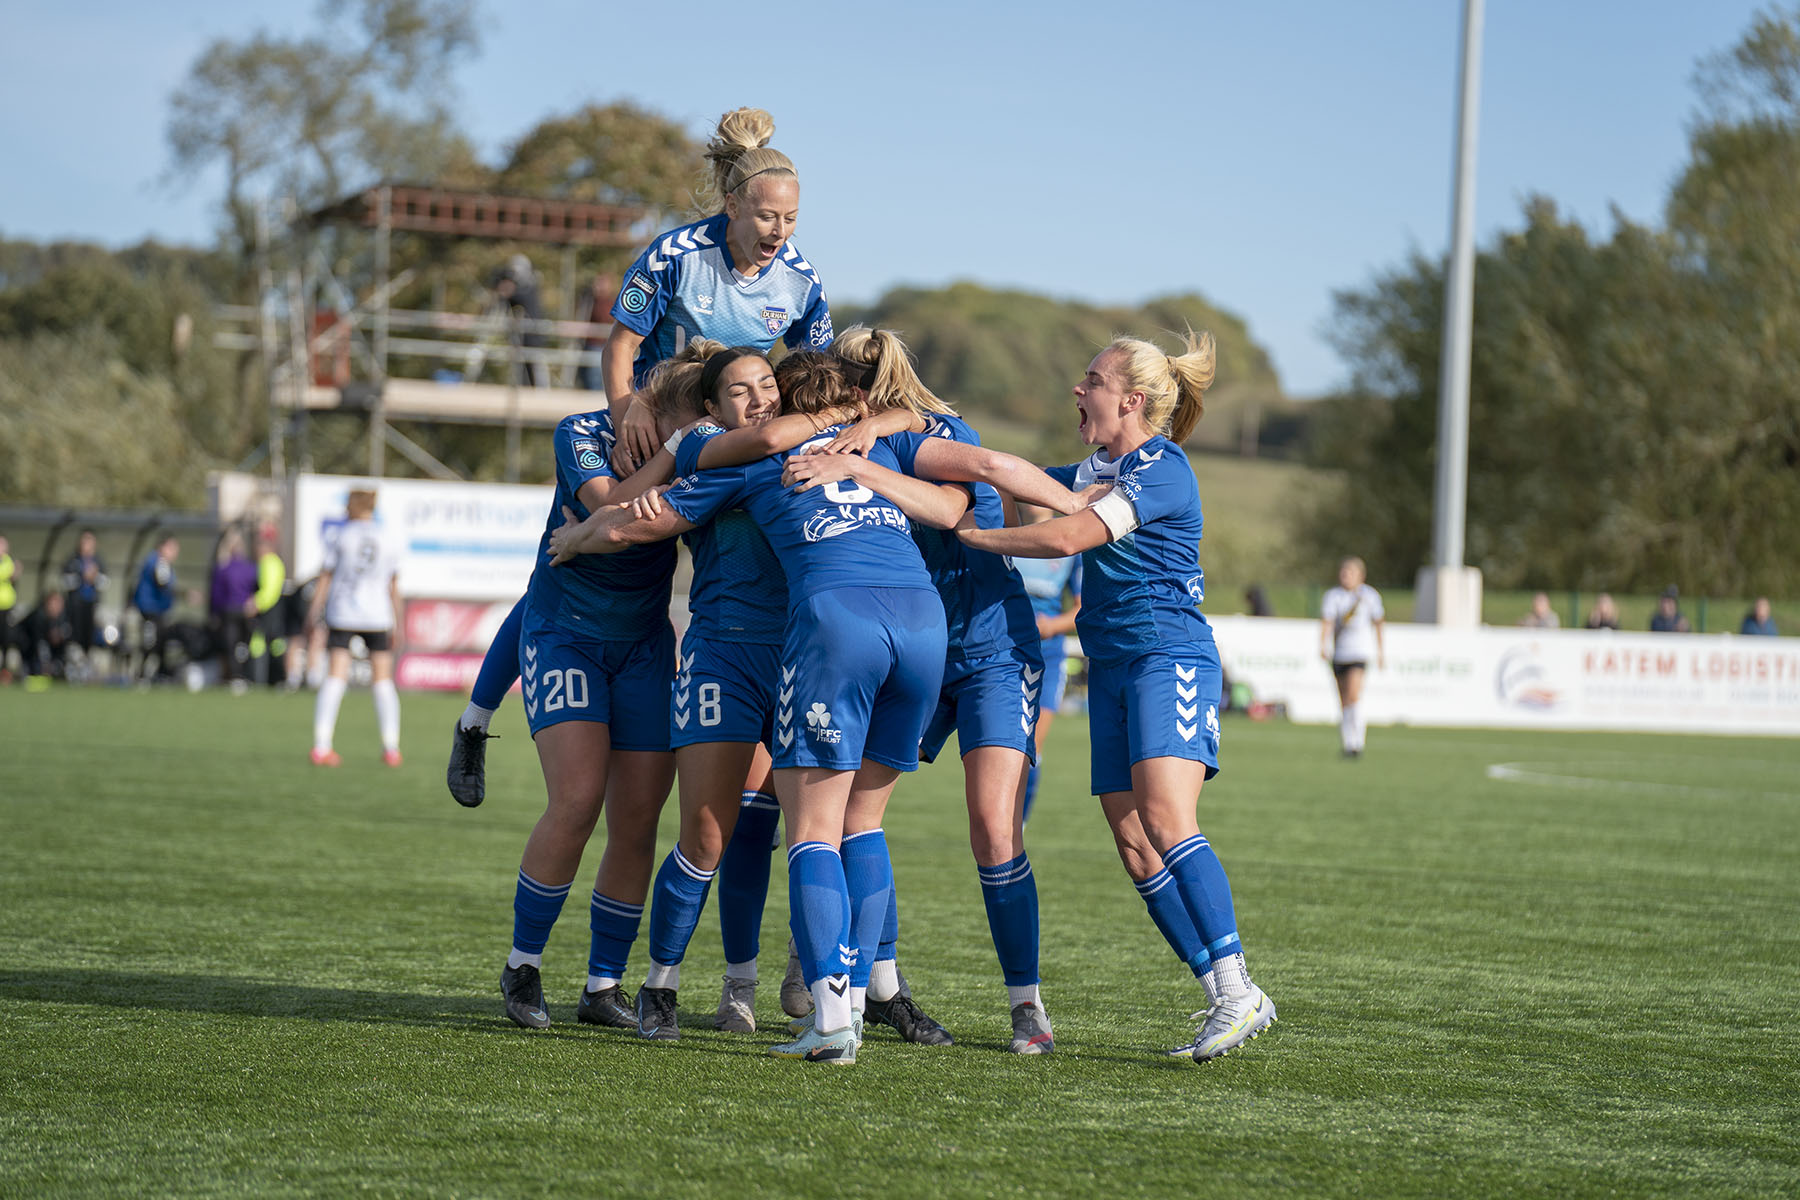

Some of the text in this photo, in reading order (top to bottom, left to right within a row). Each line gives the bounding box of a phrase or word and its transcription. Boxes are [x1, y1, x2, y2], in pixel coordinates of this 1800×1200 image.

[543, 668, 589, 712] 20
[699, 682, 721, 726] 8
[820, 728, 842, 738] PFC
